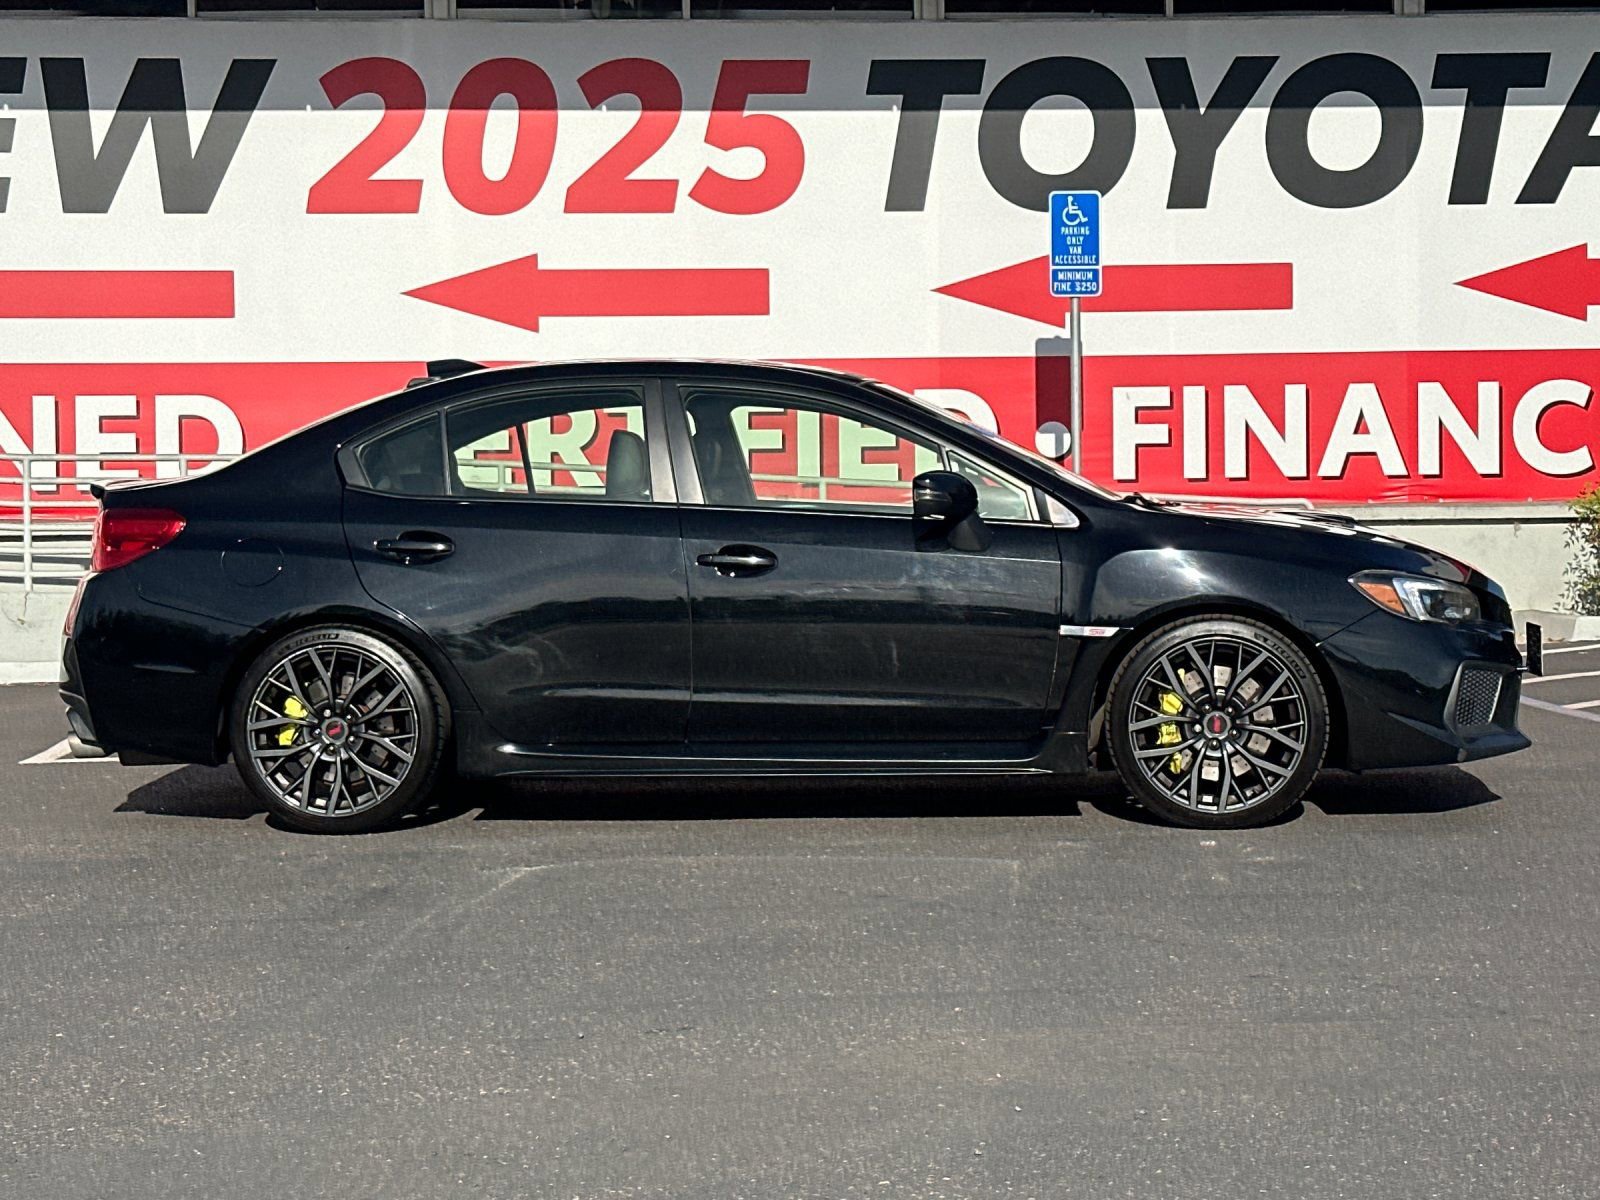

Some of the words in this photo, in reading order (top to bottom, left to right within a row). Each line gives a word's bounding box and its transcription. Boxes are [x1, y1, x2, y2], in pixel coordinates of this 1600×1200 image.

[0, 57, 277, 214] W
[306, 57, 811, 215] 2025
[1061, 226, 1090, 235] PARKING
[1066, 236, 1084, 245] ONLY
[1069, 246, 1082, 255] VAN
[1055, 255, 1097, 264] ACCESSIBLE
[1058, 271, 1093, 280] MINIMUM
[1054, 282, 1072, 291] FINE
[1074, 281, 1097, 292] $250
[1112, 379, 1595, 481] FINANC
